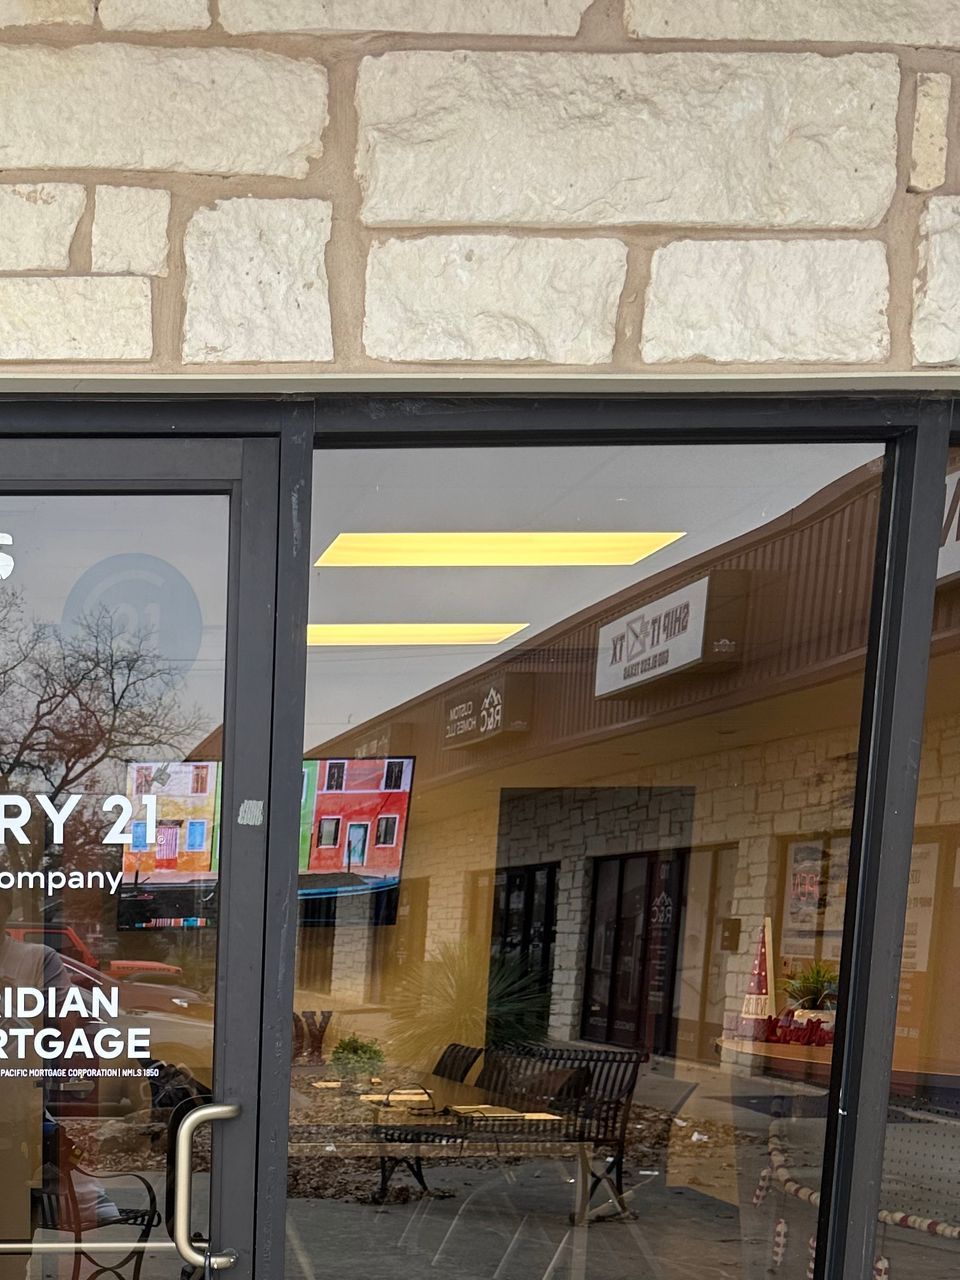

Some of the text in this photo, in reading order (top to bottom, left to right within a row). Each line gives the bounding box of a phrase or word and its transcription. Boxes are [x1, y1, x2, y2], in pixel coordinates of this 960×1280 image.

[0, 1068, 28, 1078] PACIFIC
[28, 1068, 67, 1078] MORTGAGE
[67, 1068, 117, 1078] CORPORATION
[122, 1068, 142, 1078] NMLS
